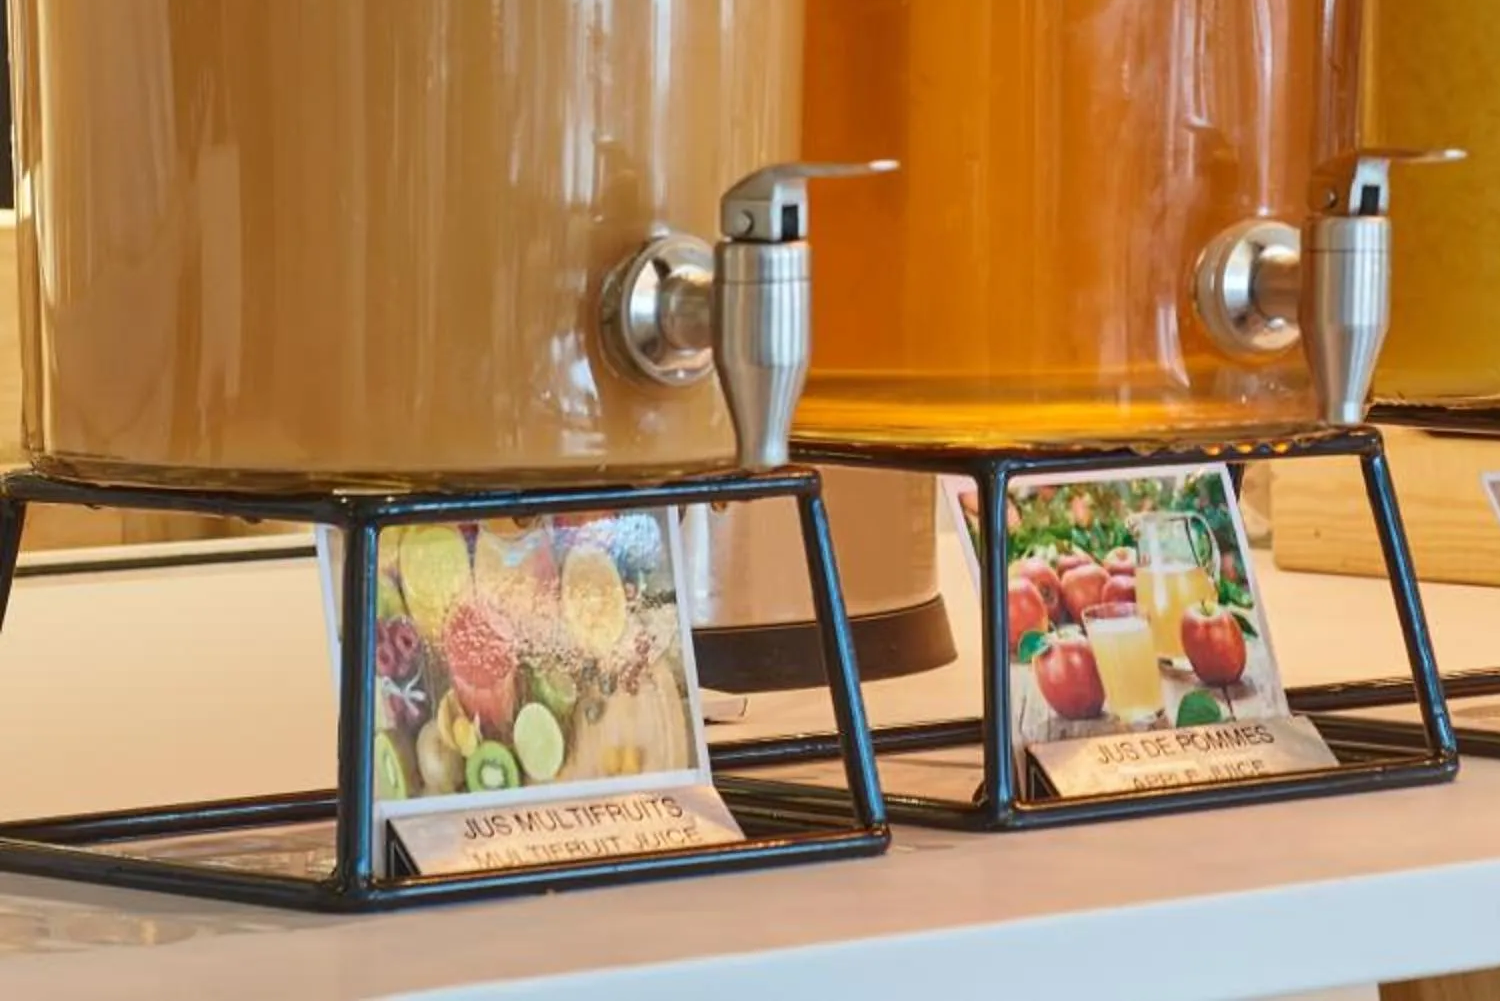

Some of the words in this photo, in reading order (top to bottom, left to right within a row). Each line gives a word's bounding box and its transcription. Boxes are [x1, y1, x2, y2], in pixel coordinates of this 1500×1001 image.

[1098, 741, 1140, 765] JUS
[1141, 736, 1176, 759] DE
[1176, 723, 1275, 753] POMMES
[464, 813, 513, 840] JUS
[513, 796, 684, 832] MULTIFRUITS
[633, 824, 703, 849] JUICE
